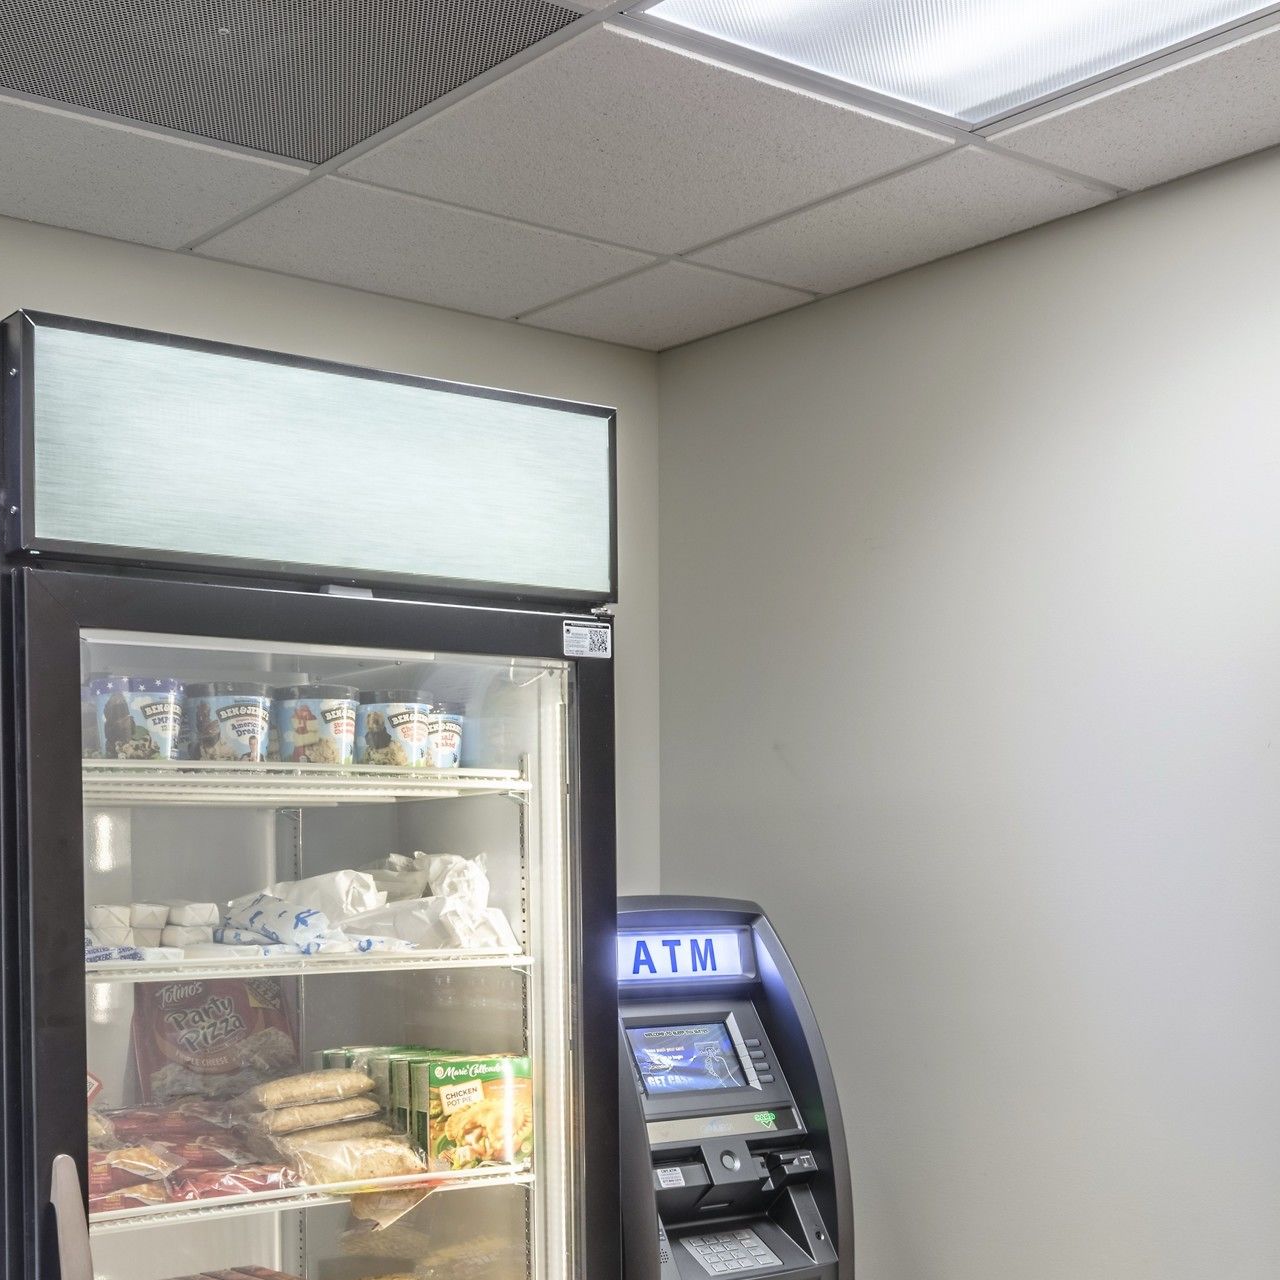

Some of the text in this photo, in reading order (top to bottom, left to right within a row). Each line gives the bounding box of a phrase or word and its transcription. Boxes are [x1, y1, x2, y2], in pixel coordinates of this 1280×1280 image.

[631, 938, 718, 976] ATM
[155, 981, 204, 1009] Totino's
[168, 996, 234, 1031] Party
[180, 1013, 246, 1052] Pizza
[445, 1085, 478, 1103] CHICKEN
[646, 1077, 667, 1087] GET
